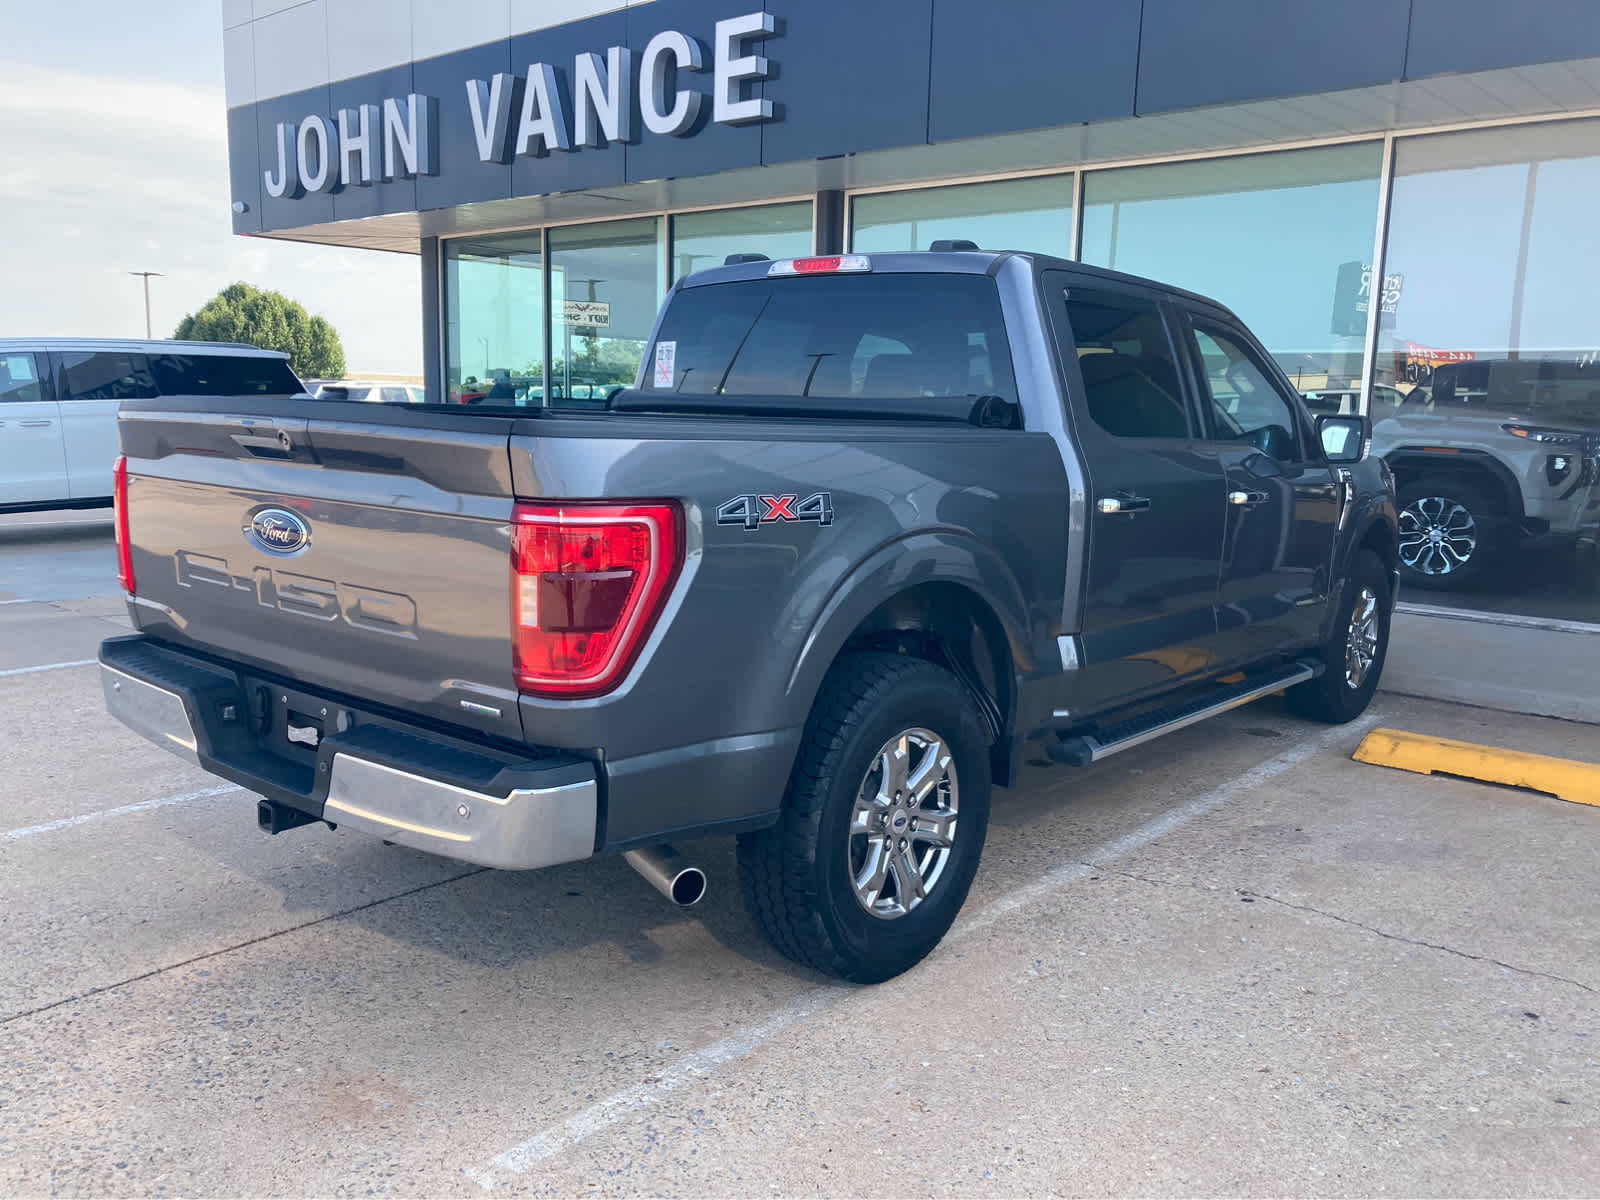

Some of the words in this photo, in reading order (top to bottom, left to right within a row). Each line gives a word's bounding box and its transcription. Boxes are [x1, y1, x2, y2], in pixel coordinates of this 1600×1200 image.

[264, 93, 437, 199] JOHN
[465, 11, 776, 164] VANCE
[261, 517, 291, 544] Ford
[174, 548, 420, 641] F-150
